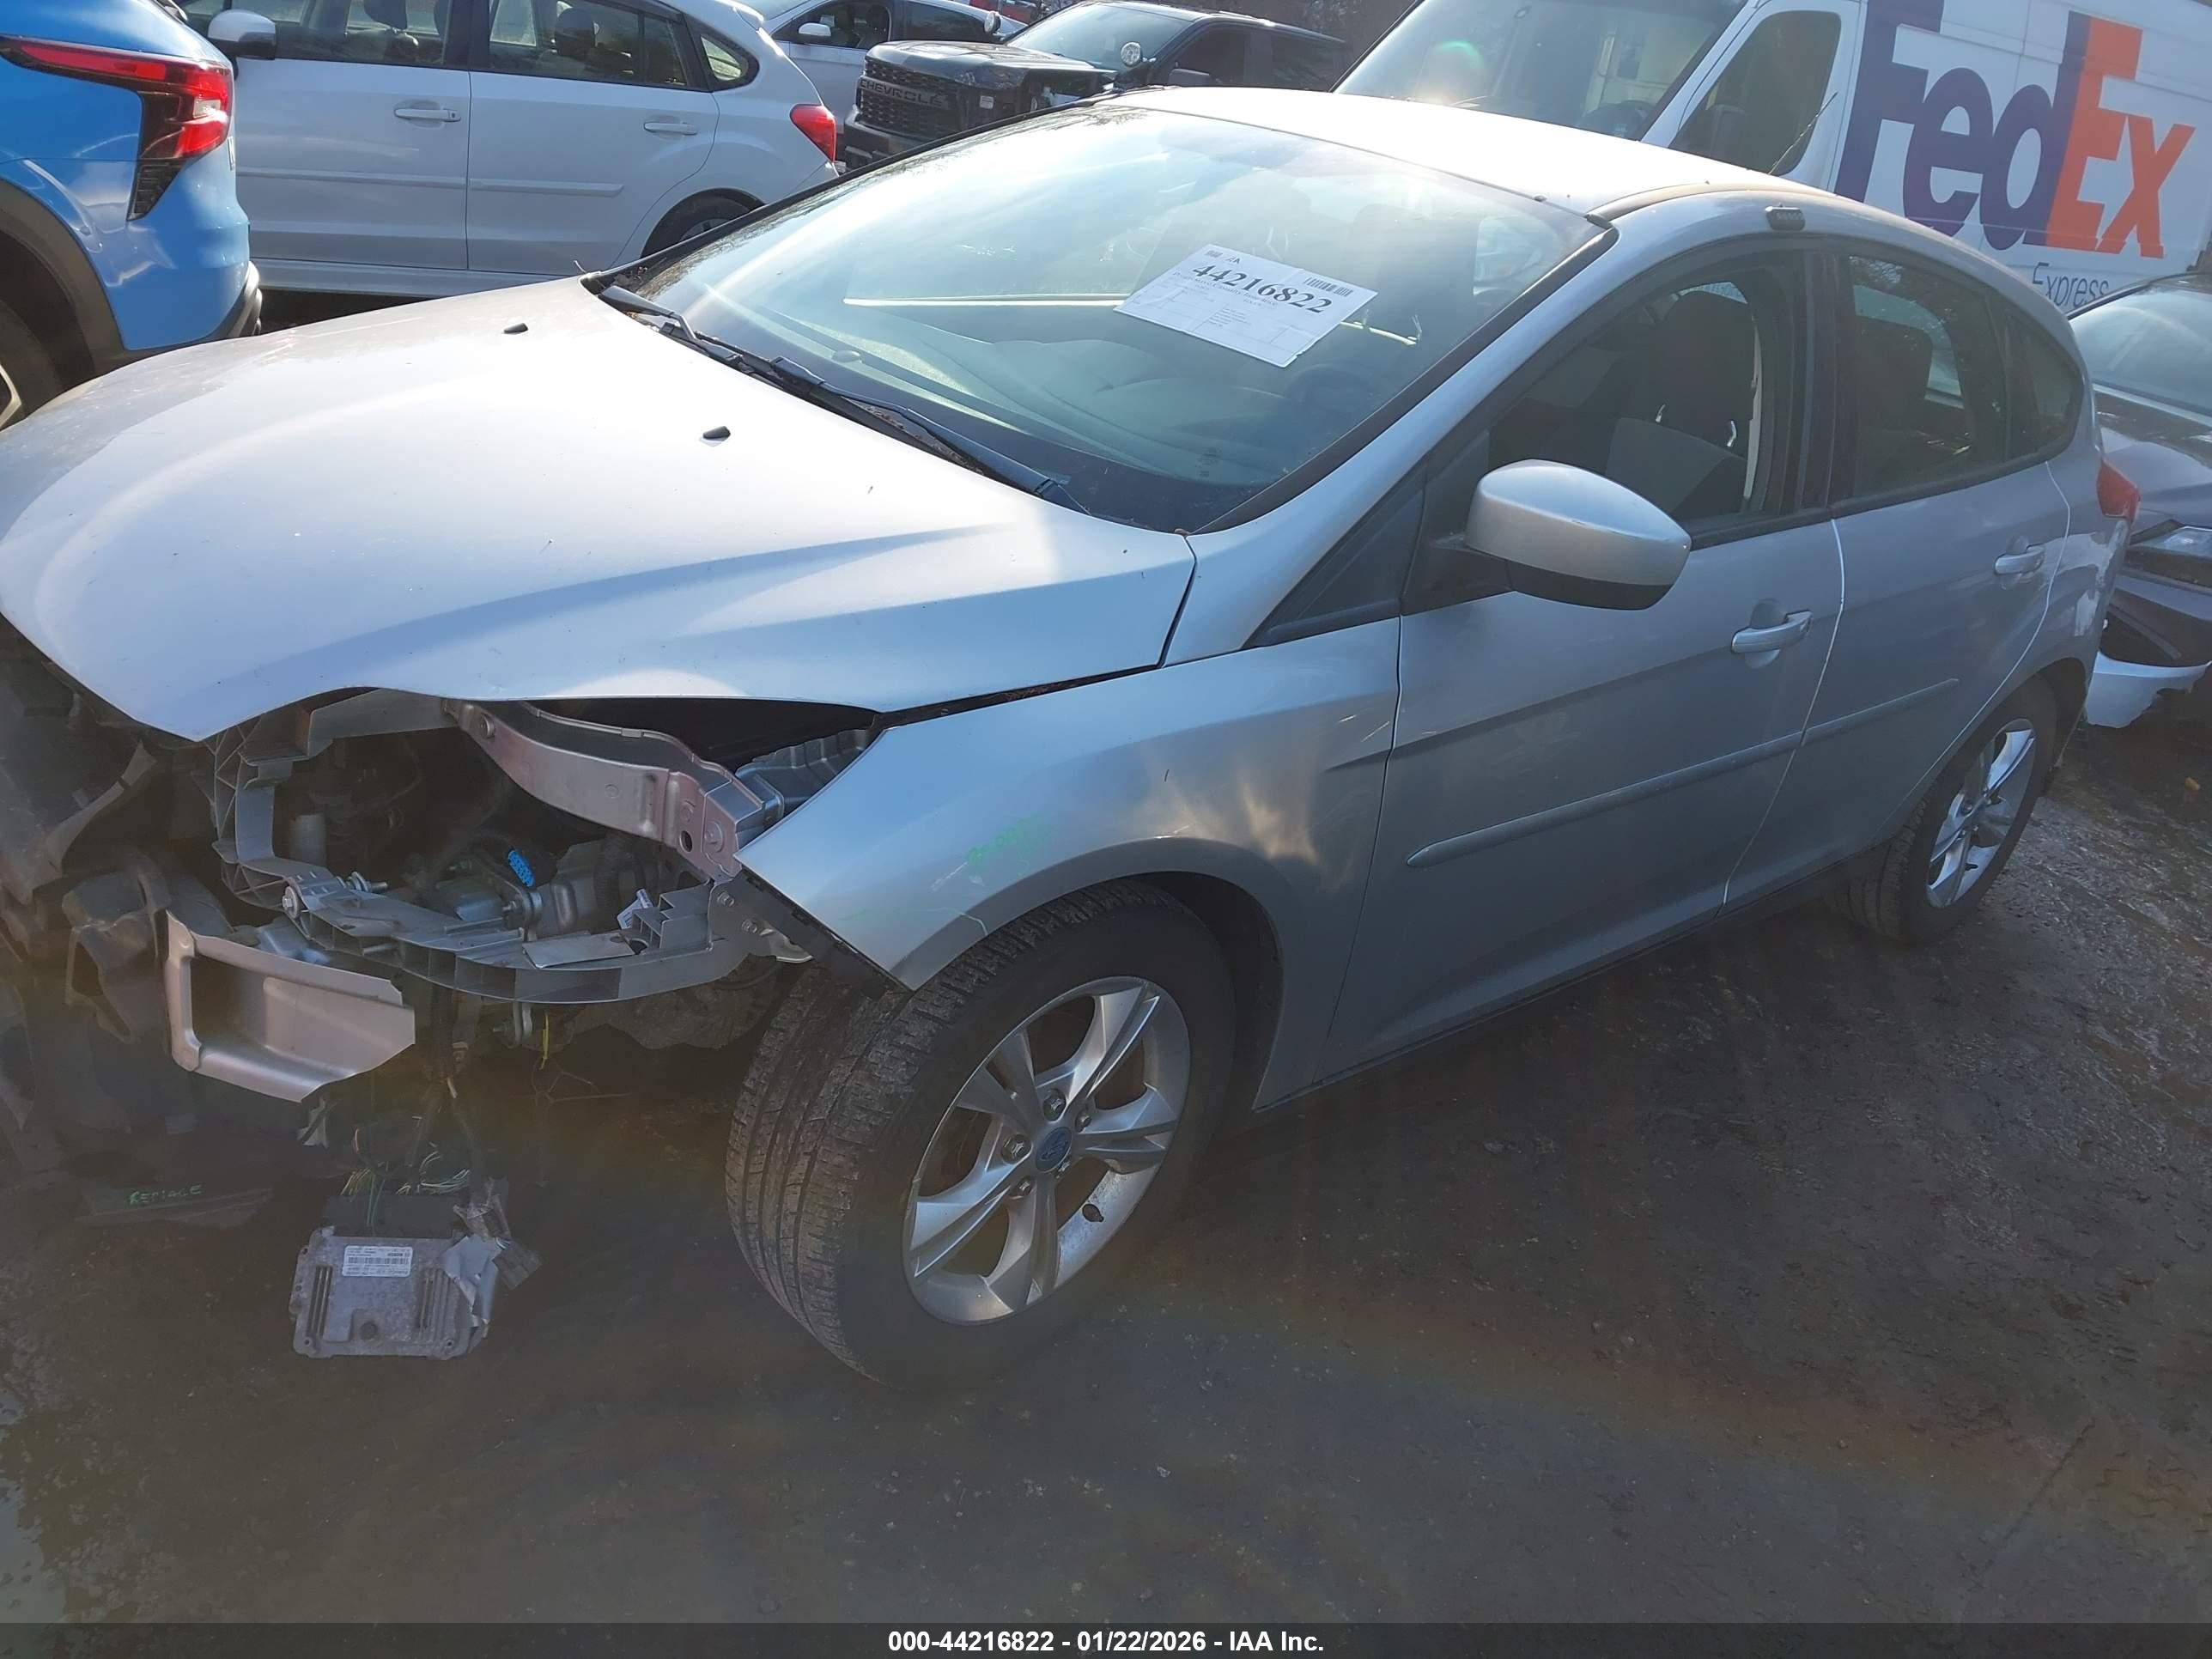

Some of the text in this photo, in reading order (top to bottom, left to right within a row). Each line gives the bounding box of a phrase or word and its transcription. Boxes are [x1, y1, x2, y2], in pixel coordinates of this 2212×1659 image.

[860, 79, 948, 108] CHEVROLE
[1834, 0, 2196, 259] FedEx
[1192, 264, 1333, 313] 44216822
